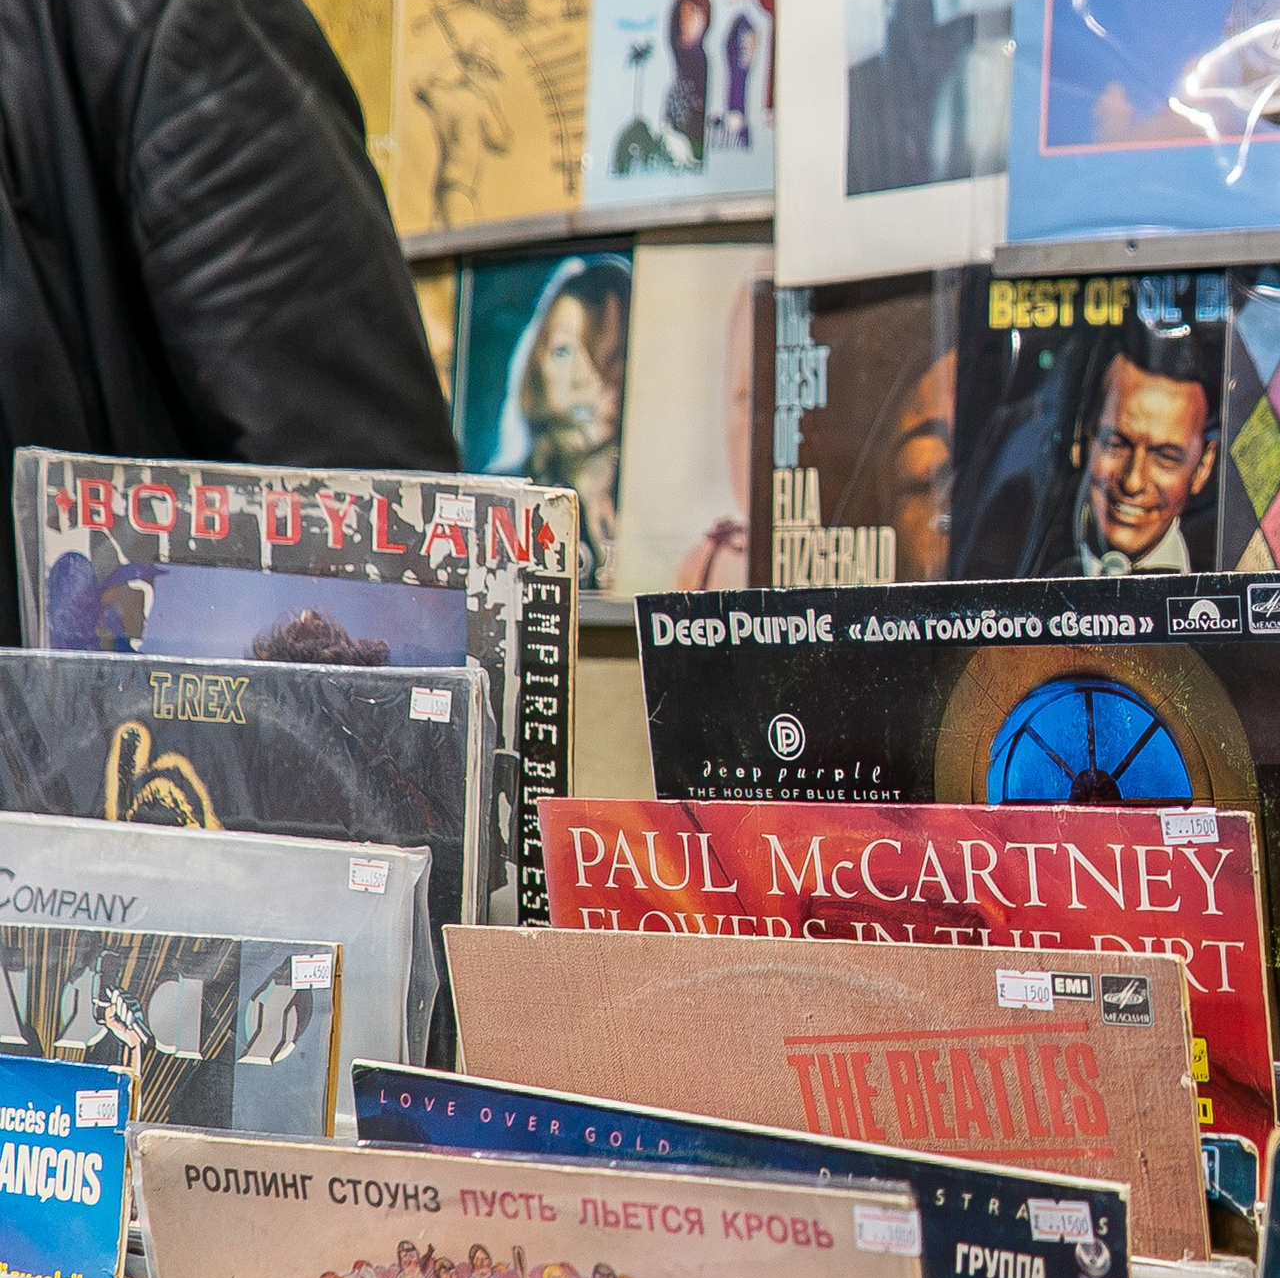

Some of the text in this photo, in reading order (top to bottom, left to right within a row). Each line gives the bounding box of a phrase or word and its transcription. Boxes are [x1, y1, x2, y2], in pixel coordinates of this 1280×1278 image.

[989, 279, 1079, 330] BEST
[1084, 277, 1131, 326] OF
[77, 477, 534, 563] BOB DYLAN
[772, 467, 822, 527] ELLA
[771, 526, 898, 588] FITZGERALD
[925, 610, 1043, 641] голубого
[1172, 616, 1239, 631] polydor
[149, 672, 250, 725] T.REX
[702, 740, 882, 784] deep purple
[688, 786, 902, 801] THE HOUSE OF BLUE LIGHT
[1190, 818, 1216, 835] 1500
[567, 826, 1235, 917] PAUL McCARTNEY
[1024, 984, 1050, 1002] 1500
[1054, 977, 1089, 995] EMI
[1103, 1012, 1150, 1023] МЕЛОДИЯ
[786, 1043, 1108, 1141] THE BEATLES
[48, 1104, 71, 1137] de
[378, 1089, 673, 1155] LOVE OVER GOLD
[183, 1163, 836, 1251] РОЛЛИНГ СТОУНЗ ПУСТЬ ЛЬЕТСЯ КРОВЬ
[933, 1186, 1110, 1237] STRAS
